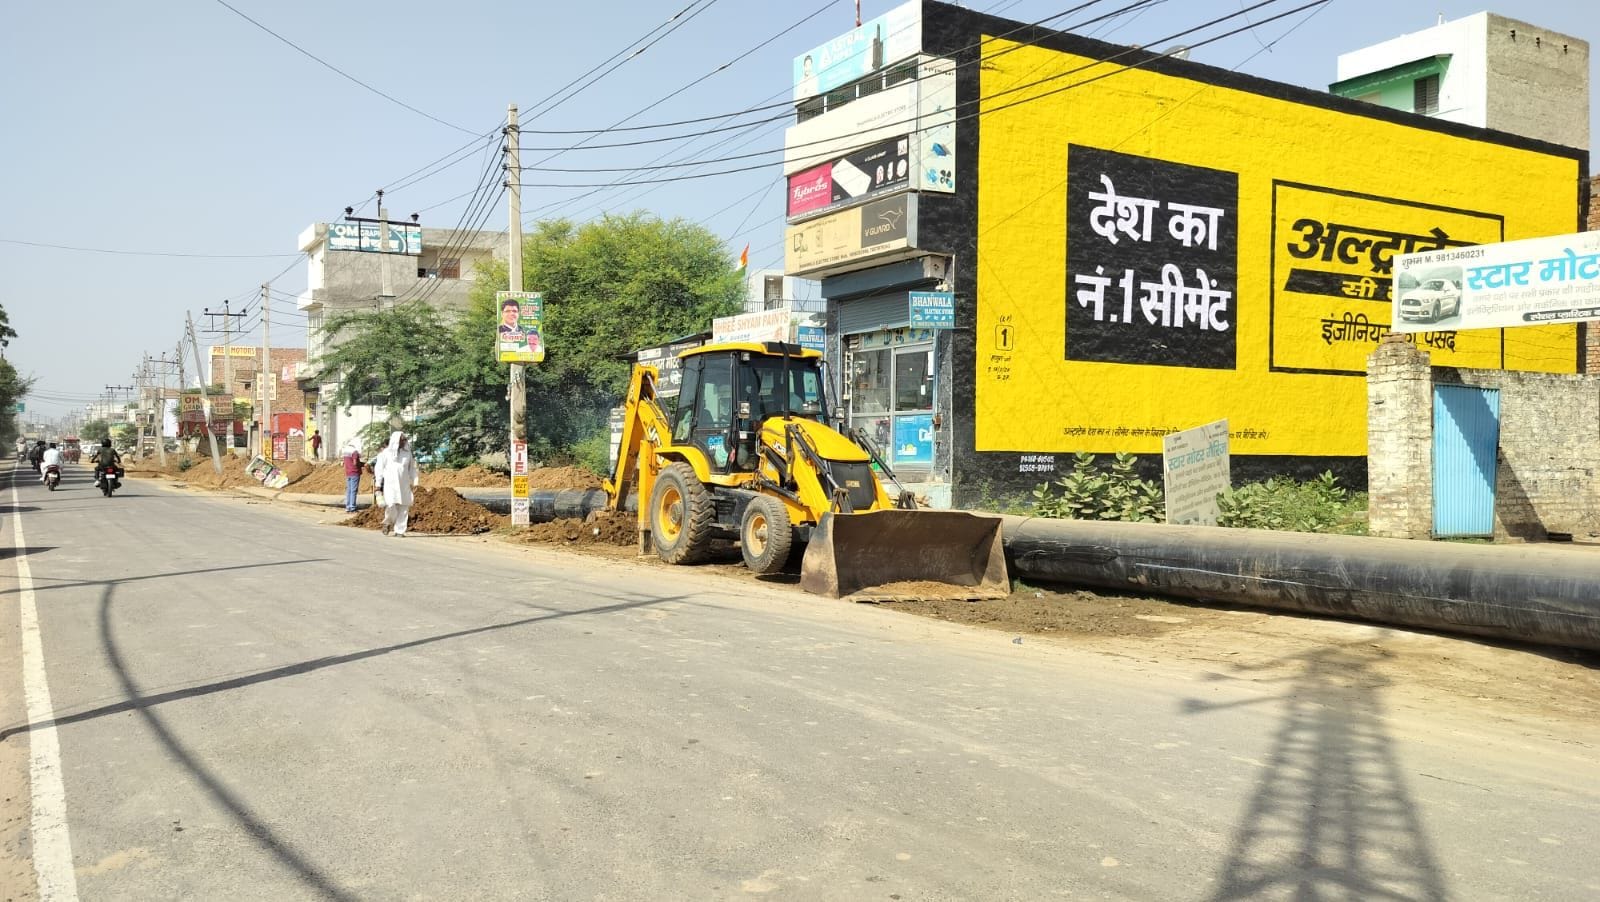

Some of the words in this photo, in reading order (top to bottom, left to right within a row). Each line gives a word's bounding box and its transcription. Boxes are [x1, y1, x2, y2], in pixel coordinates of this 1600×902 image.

[1088, 173, 1160, 245] देश
[1167, 201, 1225, 251] का
[335, 225, 359, 237] OM
[1425, 255, 1434, 263] M.
[1466, 260, 1534, 291] स्टार
[912, 296, 953, 308] BHANWALA
[1139, 263, 1232, 332] सीमेंट
[763, 310, 789, 328] PAINTS
[231, 346, 256, 355] MOTORS
[185, 396, 200, 404] OM
